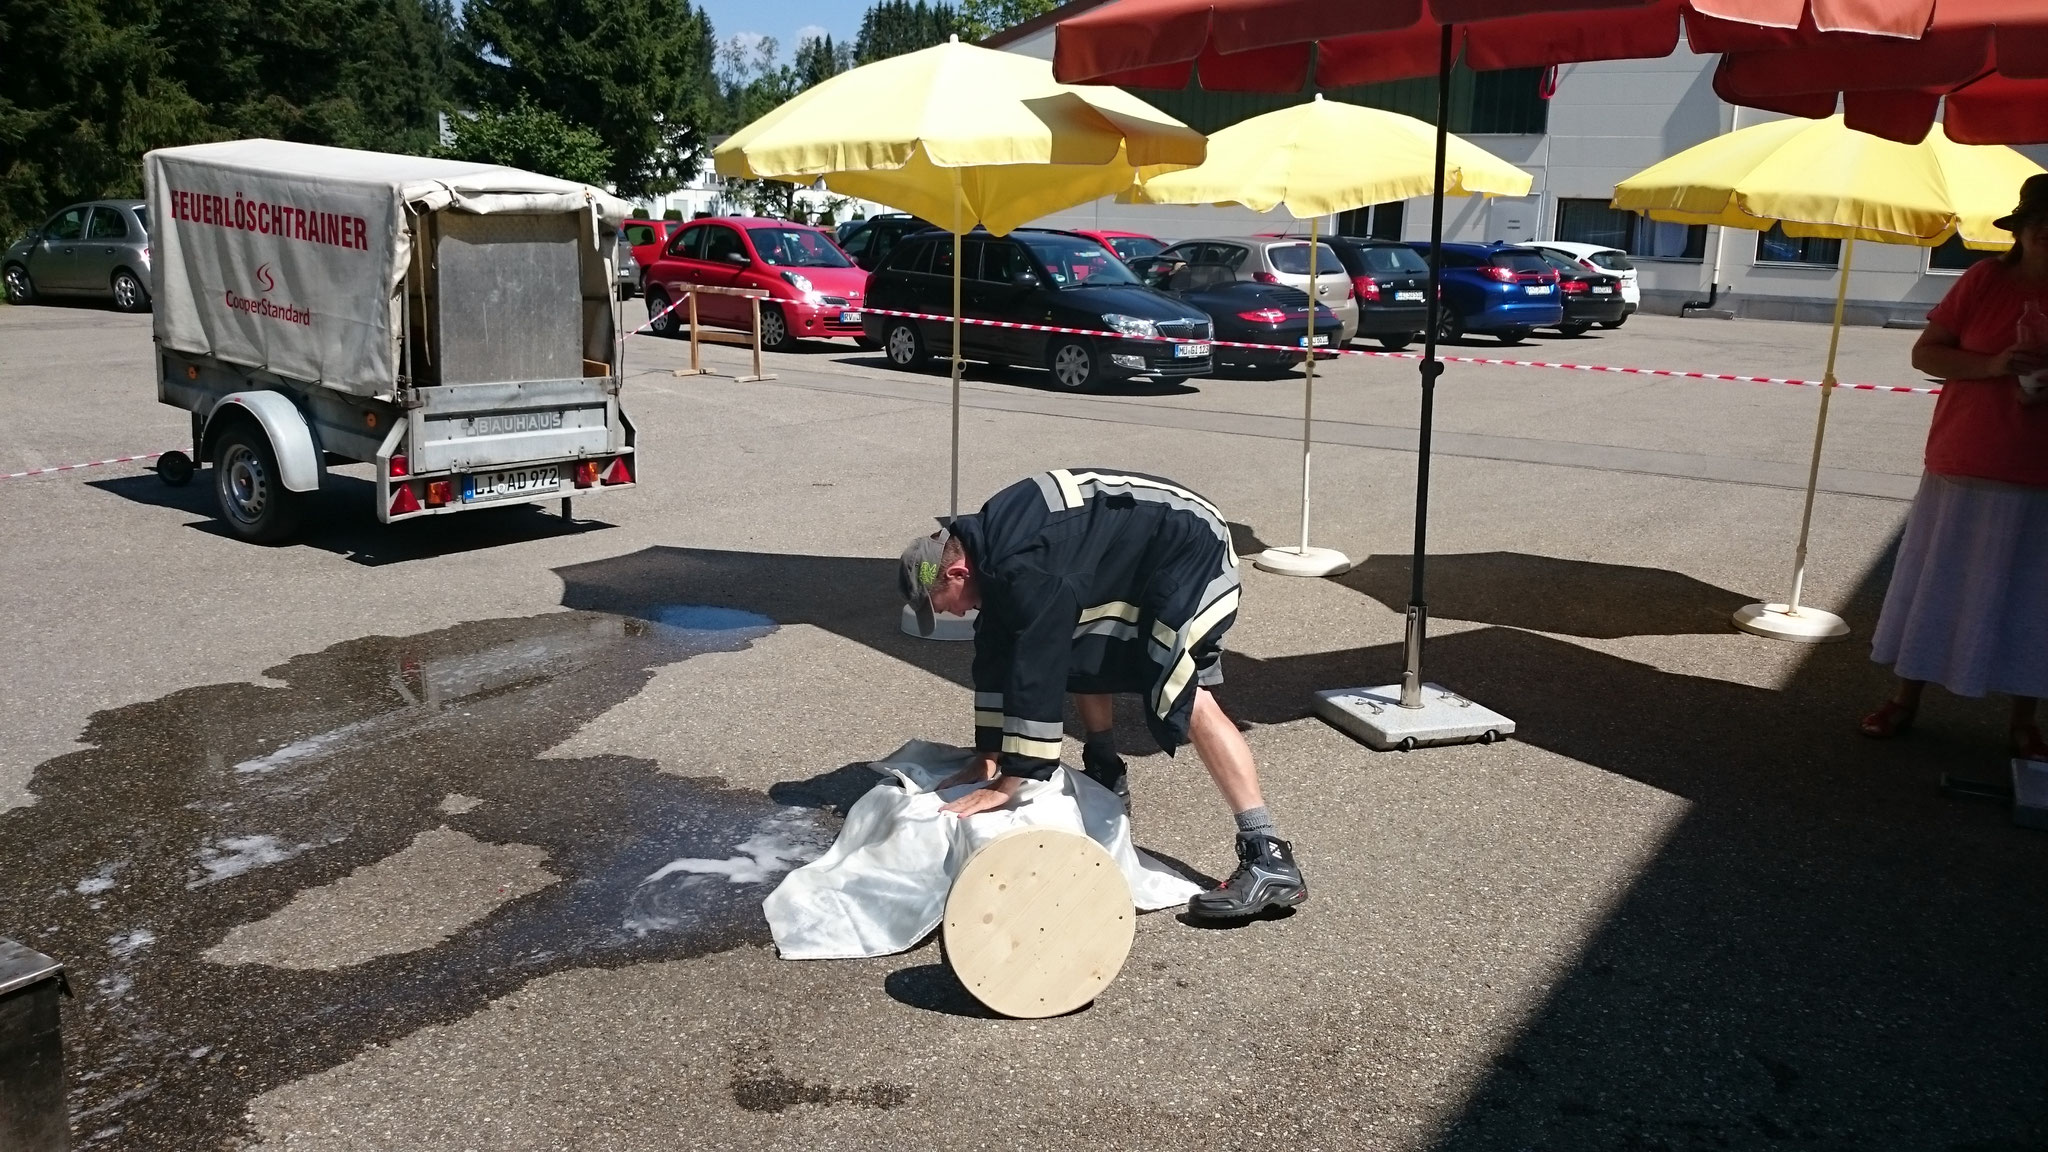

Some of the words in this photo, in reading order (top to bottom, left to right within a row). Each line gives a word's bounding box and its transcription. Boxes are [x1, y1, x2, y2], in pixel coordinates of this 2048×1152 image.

[171, 189, 369, 251] FEUERLÖSCHTRAINER
[225, 289, 311, 326] CooperStandard
[479, 413, 562, 435] BAUHAUS
[474, 475, 495, 495] LI
[507, 472, 526, 491] AD
[530, 468, 557, 487] 972
